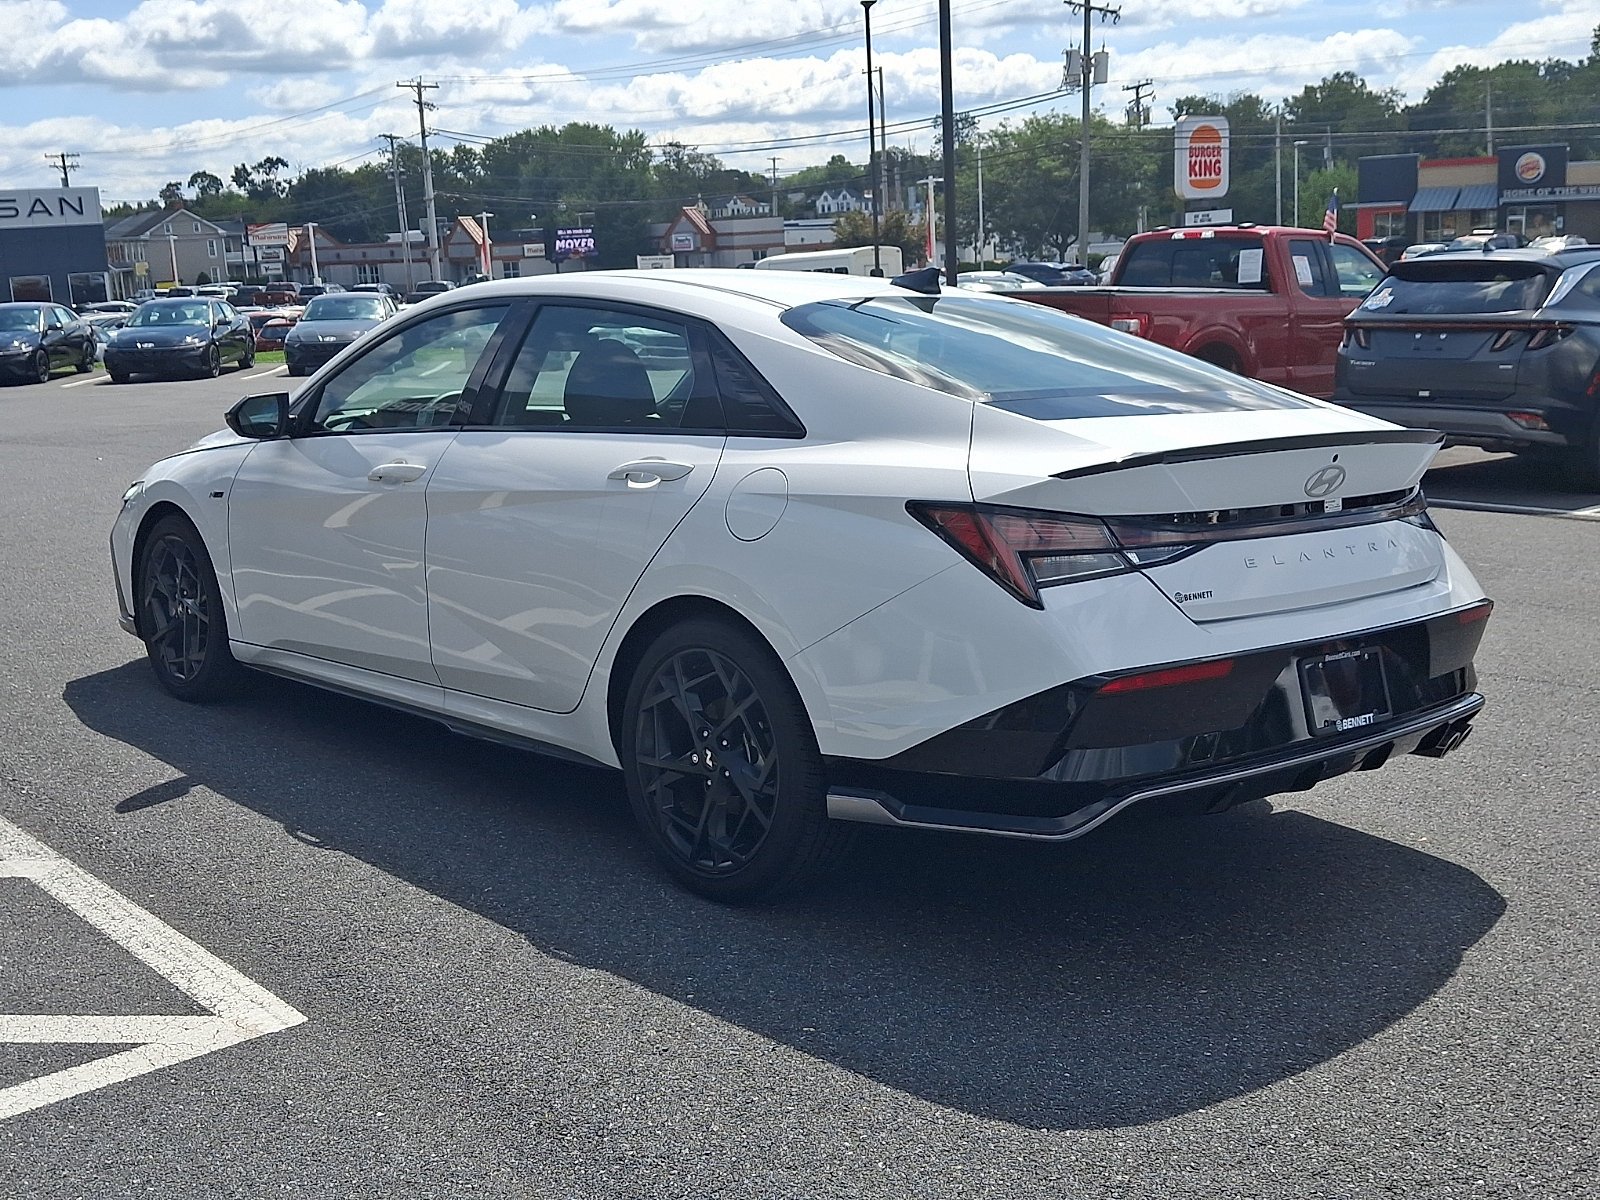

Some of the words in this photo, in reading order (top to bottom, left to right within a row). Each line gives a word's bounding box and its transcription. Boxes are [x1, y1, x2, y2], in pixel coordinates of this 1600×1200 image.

[1189, 145, 1222, 158] BURGER
[1189, 159, 1222, 178] KING
[1243, 539, 1398, 569] ELANTRA
[1183, 590, 1213, 602] BENNETT
[1342, 713, 1374, 730] BENNETT
